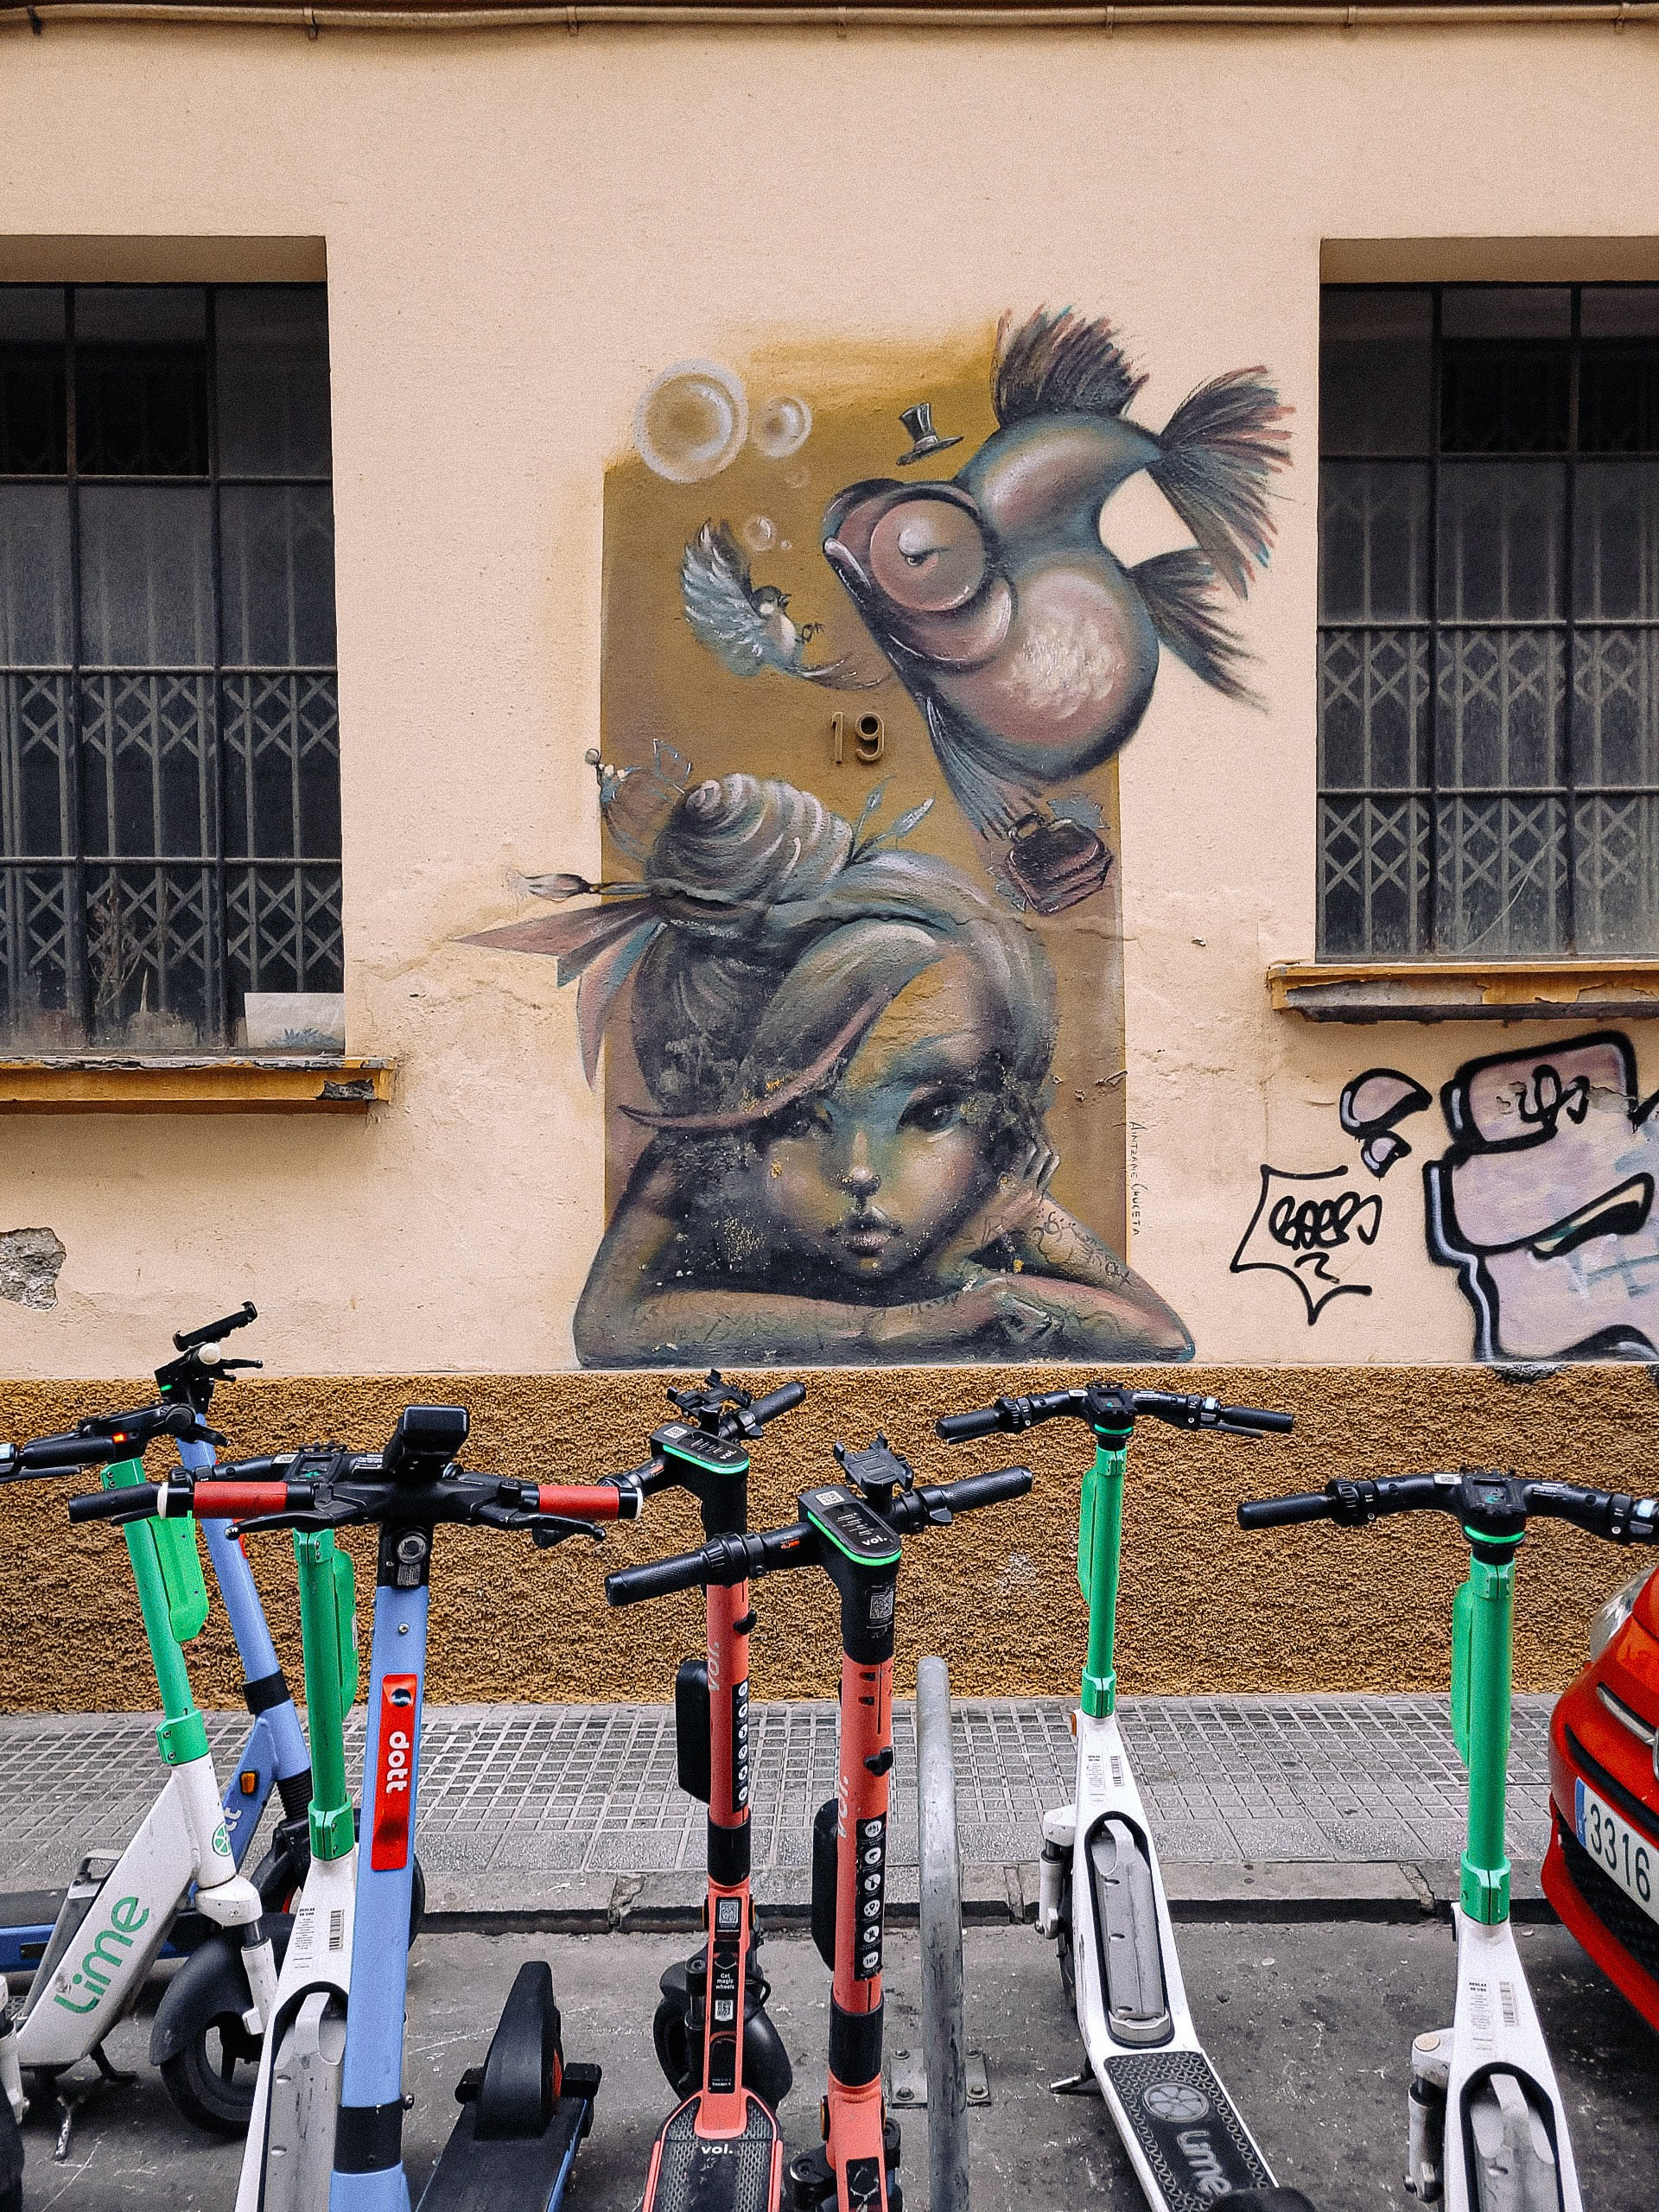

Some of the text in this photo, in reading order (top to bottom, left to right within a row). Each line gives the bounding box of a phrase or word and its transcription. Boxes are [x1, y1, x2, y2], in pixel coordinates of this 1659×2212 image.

[831, 712, 884, 762] 19
[861, 1535, 887, 1546] voi.
[385, 1731, 410, 1794] dott
[1591, 1803, 1650, 1902] 3316
[54, 1896, 150, 2013] Lime
[701, 2143, 734, 2155] voi.
